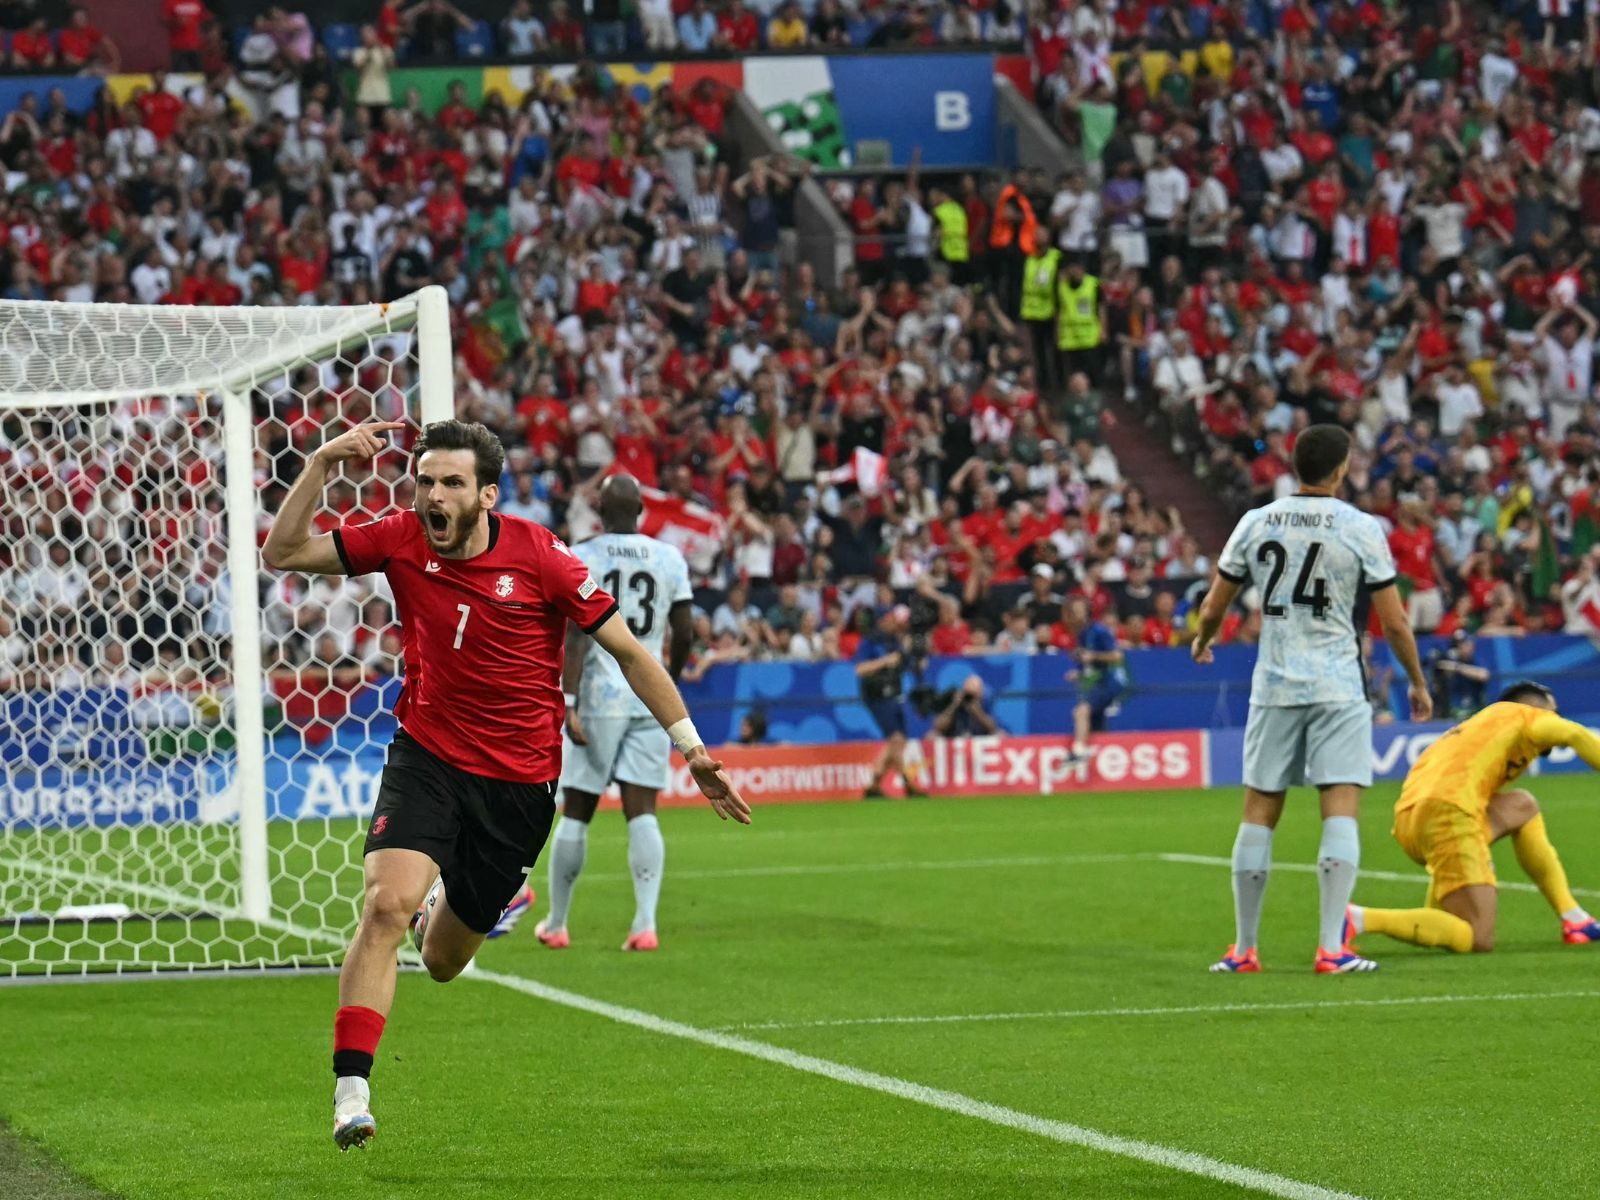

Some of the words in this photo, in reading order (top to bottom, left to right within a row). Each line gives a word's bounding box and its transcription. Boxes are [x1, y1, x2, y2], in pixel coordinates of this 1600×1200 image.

[935, 91, 970, 130] B
[607, 545, 649, 559] DANILO
[603, 569, 656, 637] 13
[1257, 541, 1331, 619] 24
[453, 603, 471, 649] 7
[892, 734, 1191, 794] AliExpress
